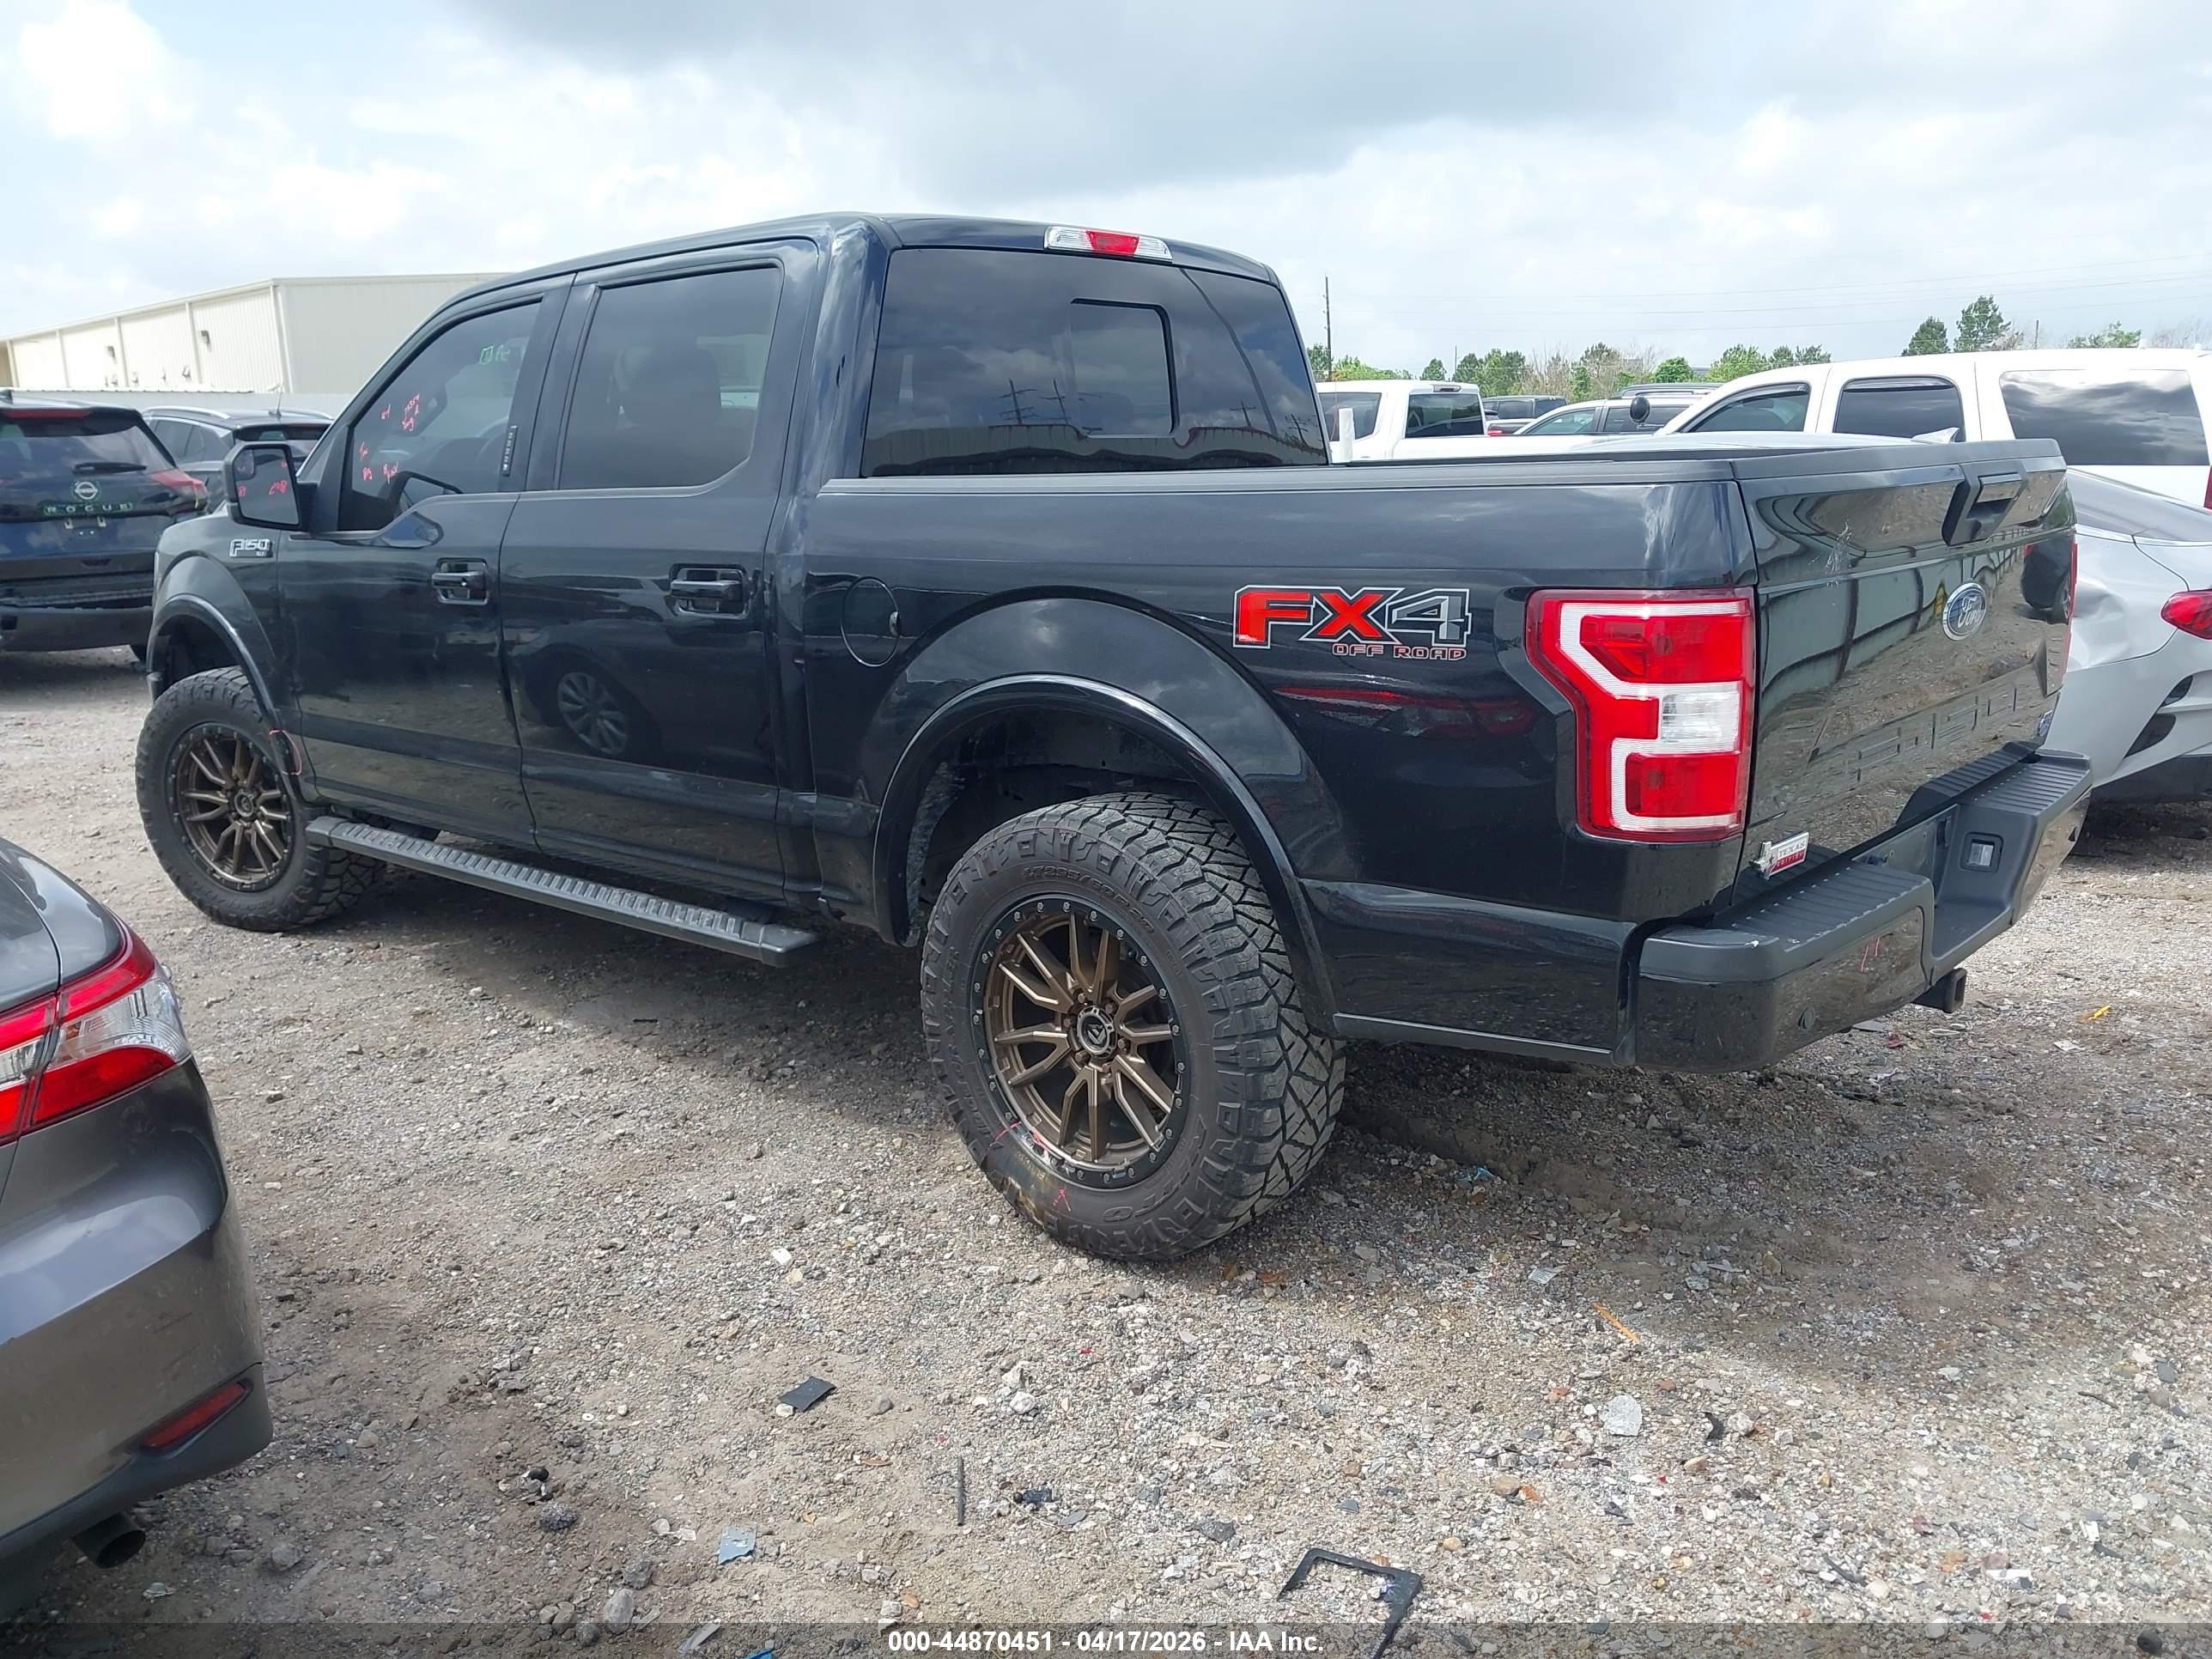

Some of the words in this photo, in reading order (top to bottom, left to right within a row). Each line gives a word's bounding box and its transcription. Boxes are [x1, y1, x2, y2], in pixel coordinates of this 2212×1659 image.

[1233, 585, 1471, 648] FX4
[1957, 596, 1981, 628] Ford
[1333, 644, 1384, 657] OFF
[1393, 645, 1467, 660] ROAD
[1778, 840, 1807, 859] TEXAS
